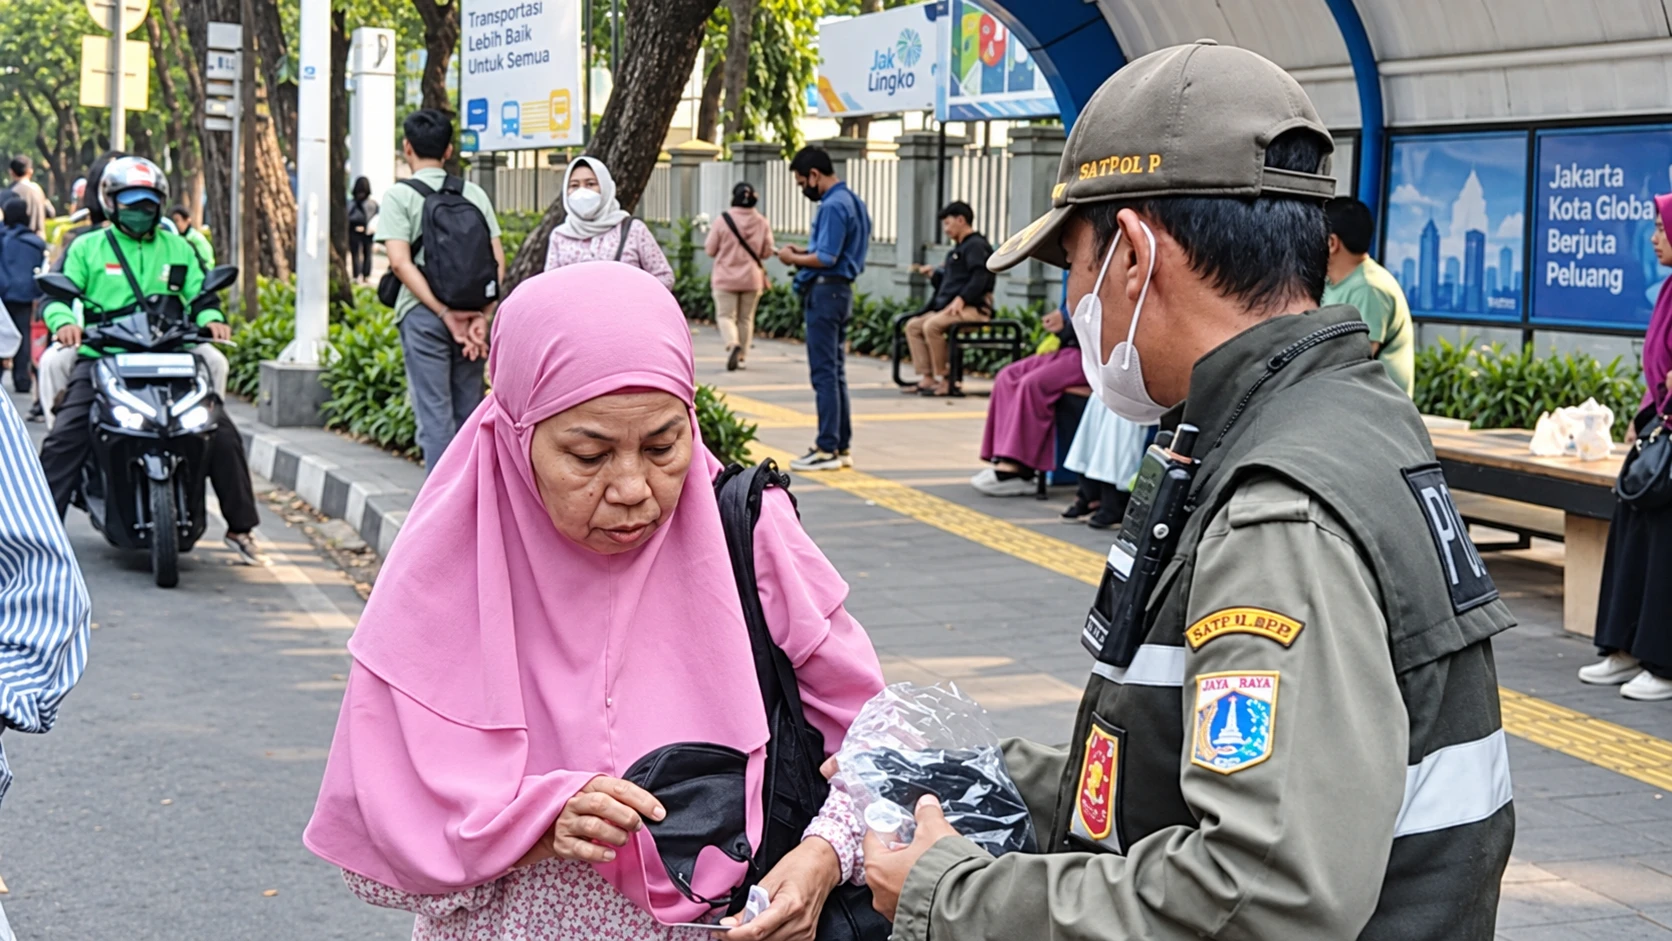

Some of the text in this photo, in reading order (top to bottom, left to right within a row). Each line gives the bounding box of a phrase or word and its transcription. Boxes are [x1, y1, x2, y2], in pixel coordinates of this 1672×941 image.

[468, 1, 543, 27] Transportasi
[468, 24, 532, 52] Lebih Baik
[468, 49, 550, 75] Untuk Semua
[870, 46, 895, 71] Jak
[868, 68, 915, 96] Lingko
[1079, 155, 1143, 180] SATPOL
[1549, 162, 1624, 189] Jakarta
[1548, 194, 1655, 221] Kota Globa
[1547, 228, 1617, 260] Berjuta
[1546, 261, 1623, 295] Peluang
[1203, 677, 1271, 691] JAYA RAYA
